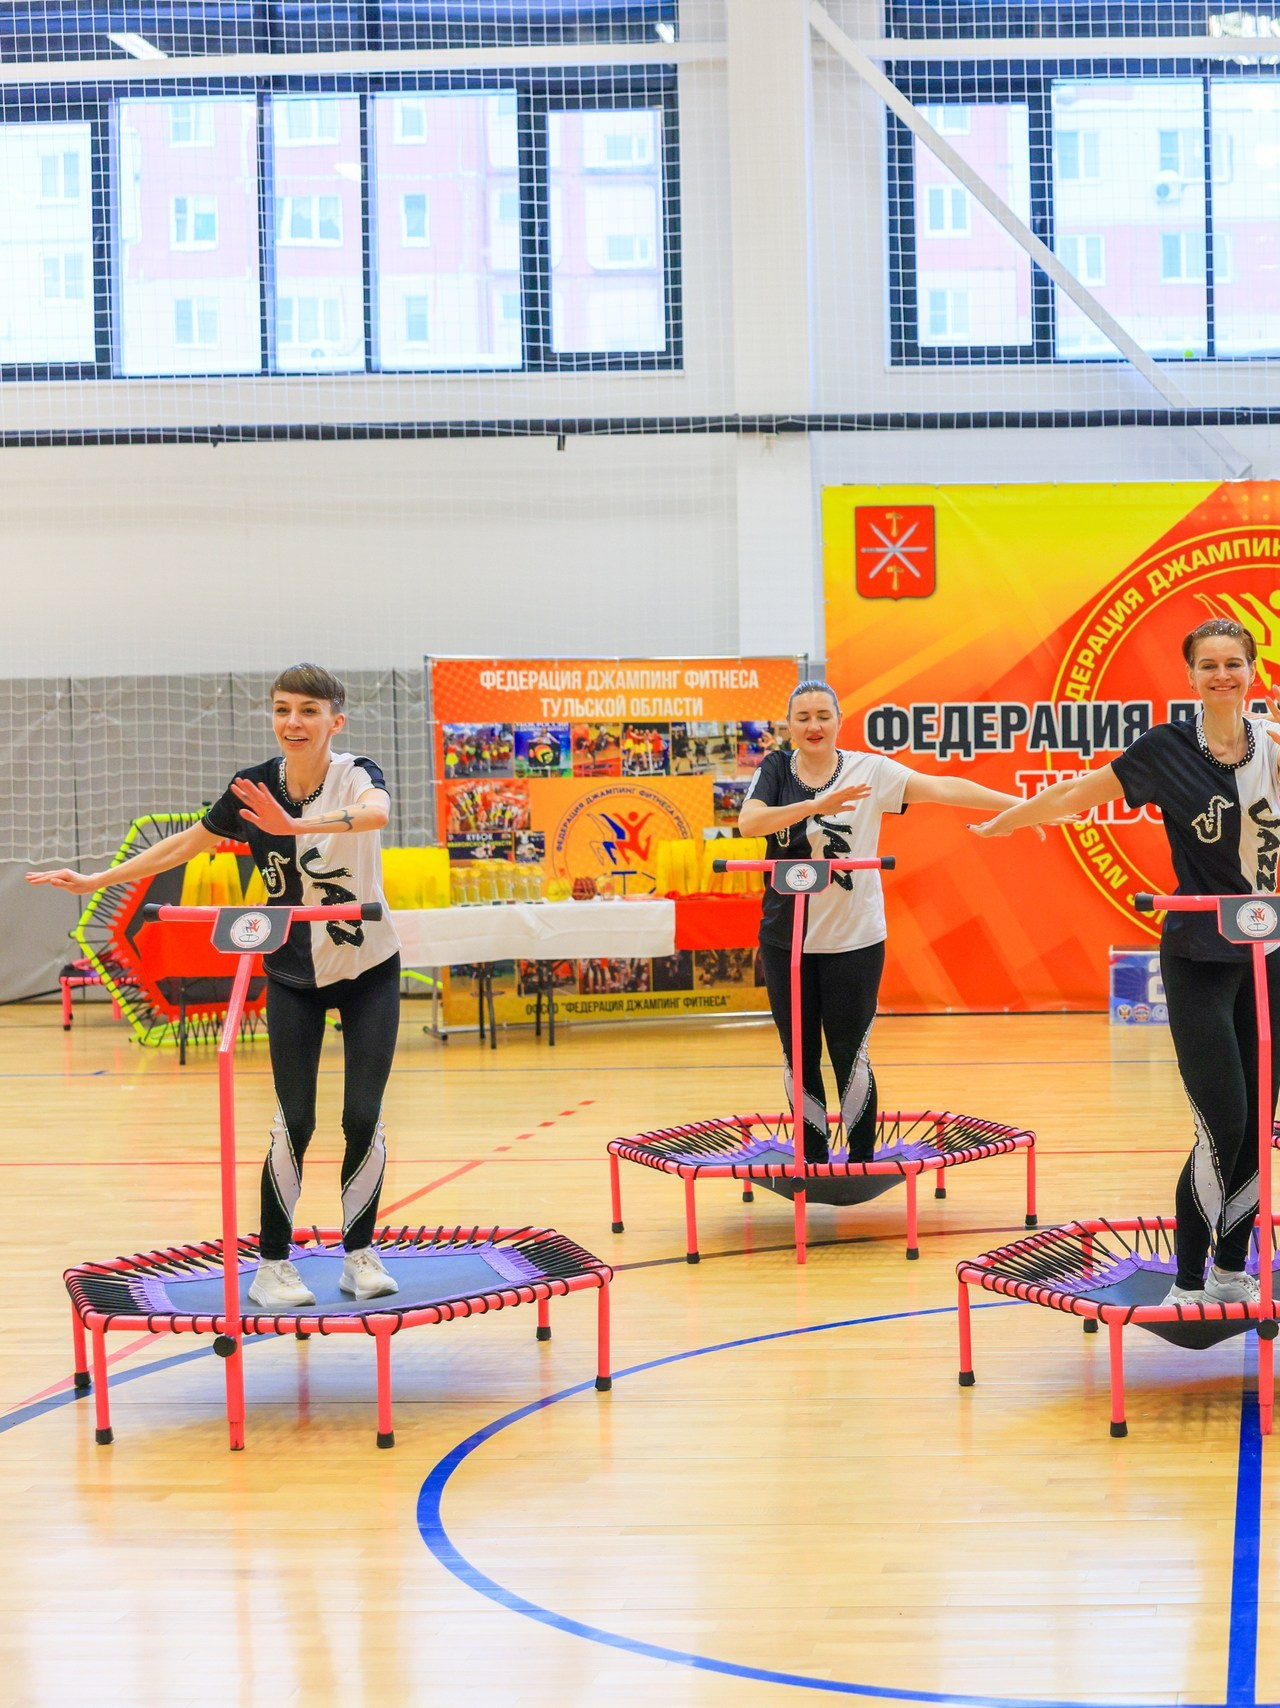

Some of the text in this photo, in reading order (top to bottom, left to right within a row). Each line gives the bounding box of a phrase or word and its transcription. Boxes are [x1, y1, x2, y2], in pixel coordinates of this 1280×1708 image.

[479, 668, 760, 692] ФЕДЕРАЦИЯ ДЖАМПИНГ ФИТНЕСА
[540, 694, 704, 718] ТУЛЬСКОЙ ОБЛАСТИ
[866, 701, 1153, 760] ФЕДЕРАЦИЯ
[585, 787, 637, 806] ДЖАМПИНГ
[638, 789, 675, 816] ФИТНЕСА
[626, 997, 681, 1012] ДЖАМПИНГ
